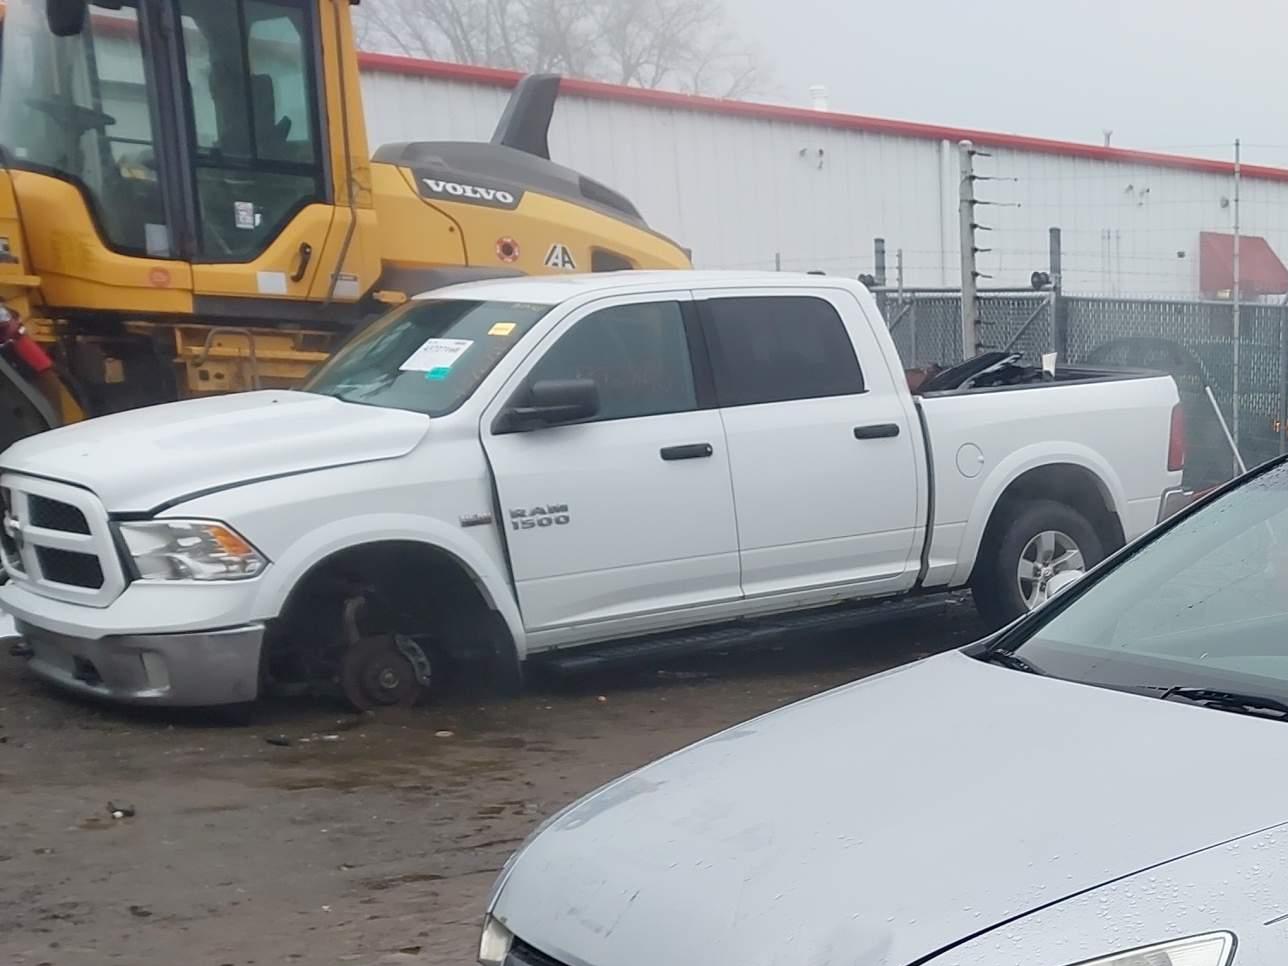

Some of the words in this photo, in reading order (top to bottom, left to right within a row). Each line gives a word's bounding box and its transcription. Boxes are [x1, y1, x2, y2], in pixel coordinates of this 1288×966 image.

[422, 178, 514, 203] VOLVO
[509, 504, 569, 519] RAM
[511, 514, 571, 531] 1500
